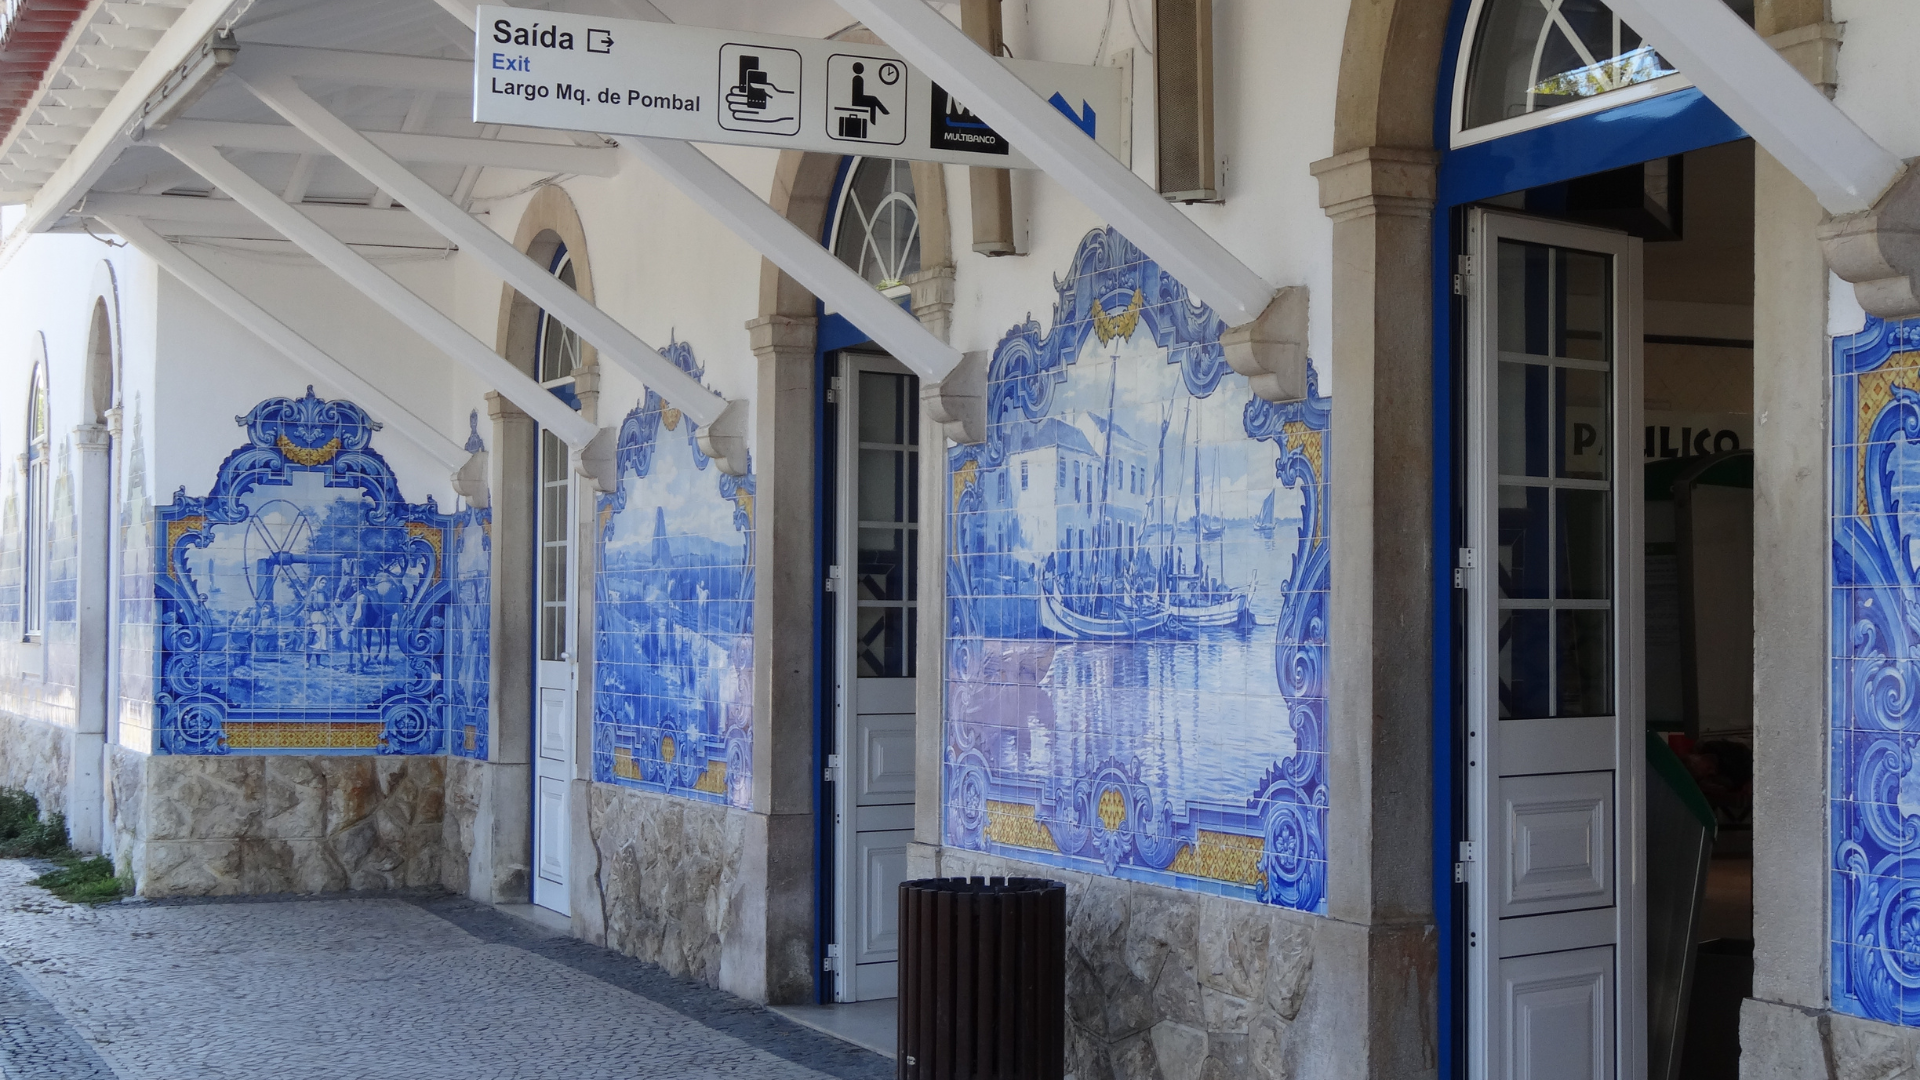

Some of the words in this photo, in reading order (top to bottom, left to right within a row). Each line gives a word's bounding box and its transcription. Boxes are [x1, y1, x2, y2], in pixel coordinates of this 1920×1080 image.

[493, 19, 574, 50] Saída
[492, 52, 531, 73] Exit
[491, 77, 549, 100] Largo
[556, 83, 591, 105] Mq.
[597, 87, 621, 105] de
[628, 89, 700, 112] Pombal
[944, 132, 996, 144] MULTIBANCO
[1573, 422, 1740, 458] PLICO
